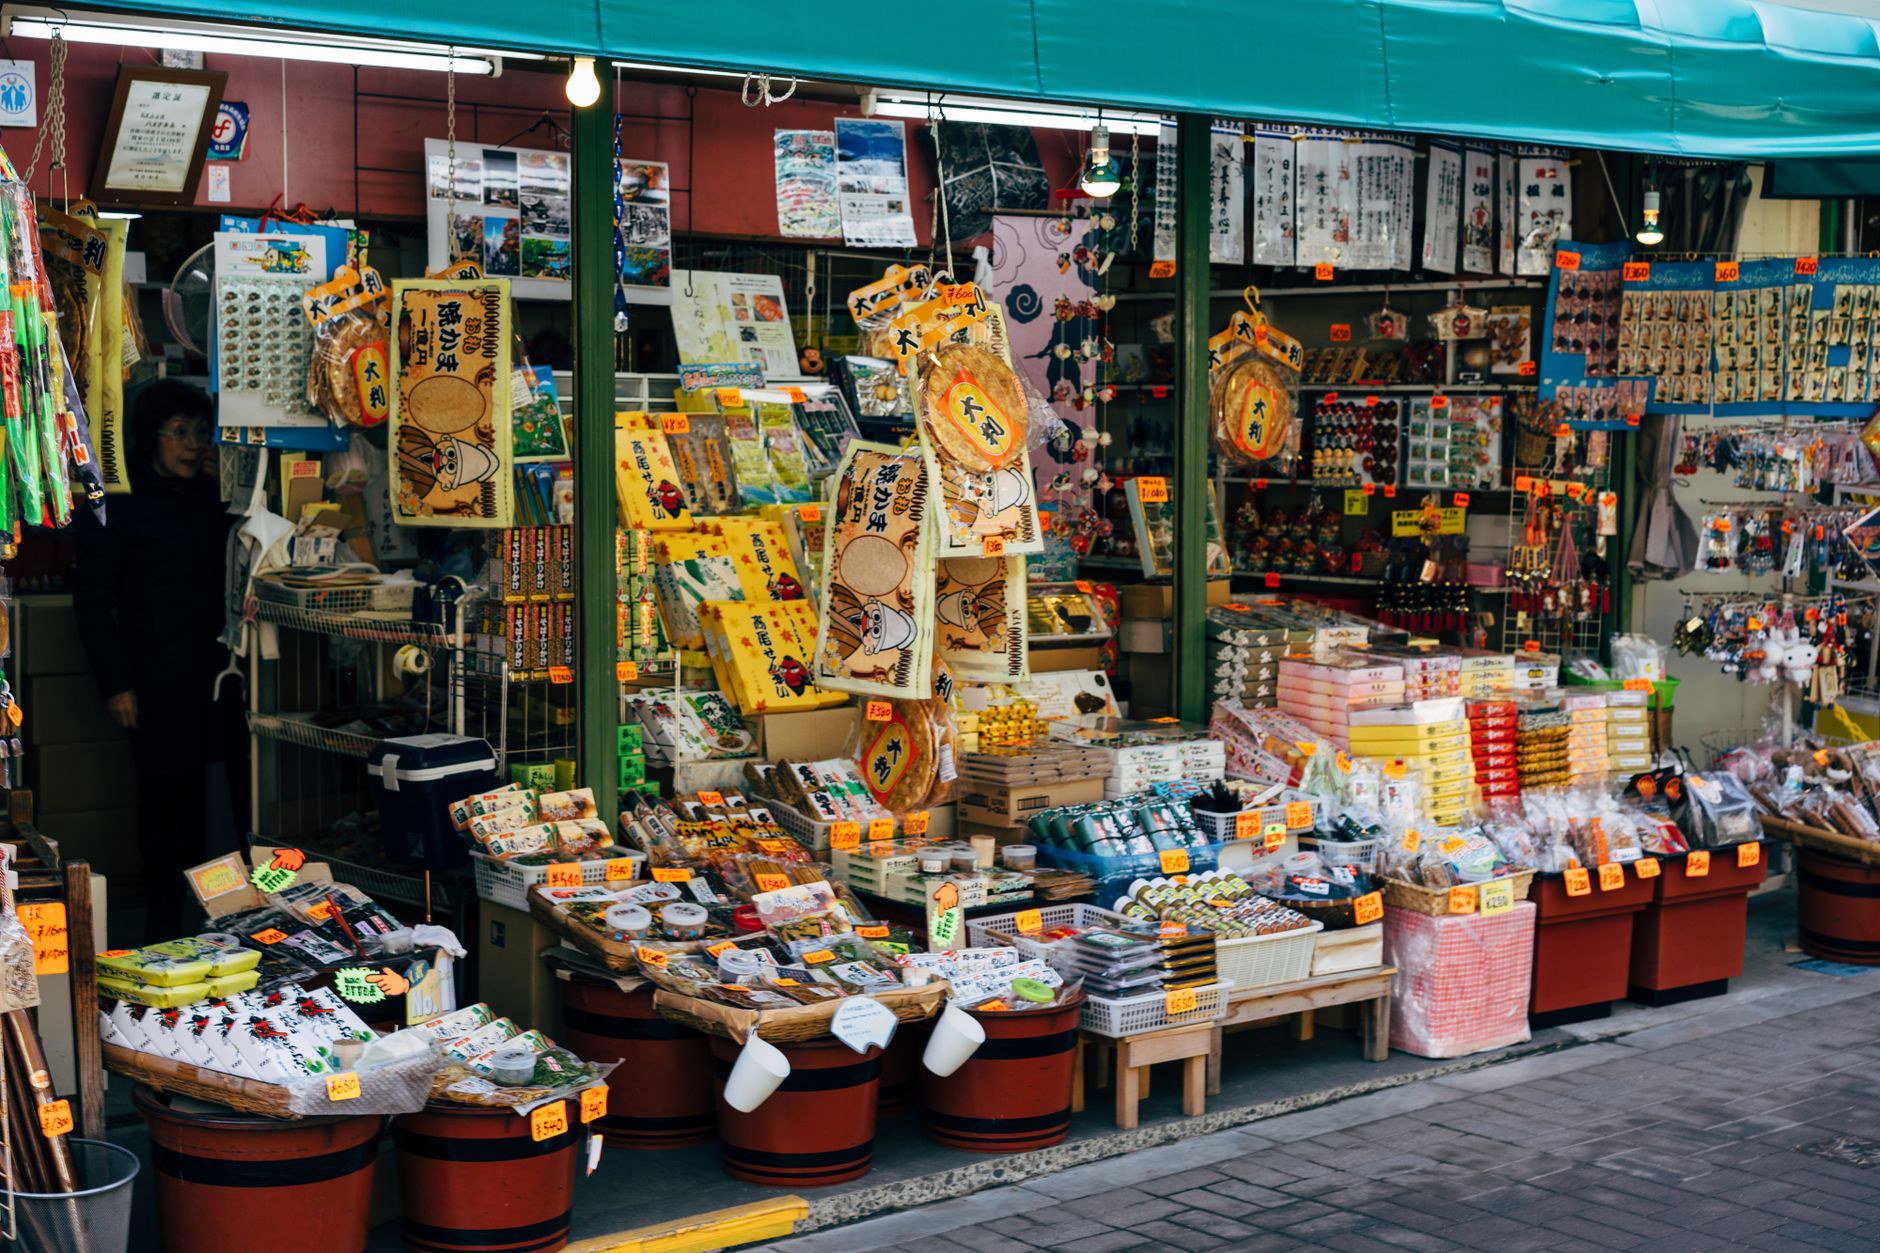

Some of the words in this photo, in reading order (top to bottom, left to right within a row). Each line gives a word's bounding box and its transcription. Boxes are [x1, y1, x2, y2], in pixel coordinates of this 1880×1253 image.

[363, 360, 385, 410] 大判
[961, 396, 1005, 447] 大判
[1249, 398, 1267, 444] 大判
[873, 737, 903, 786] 大判
